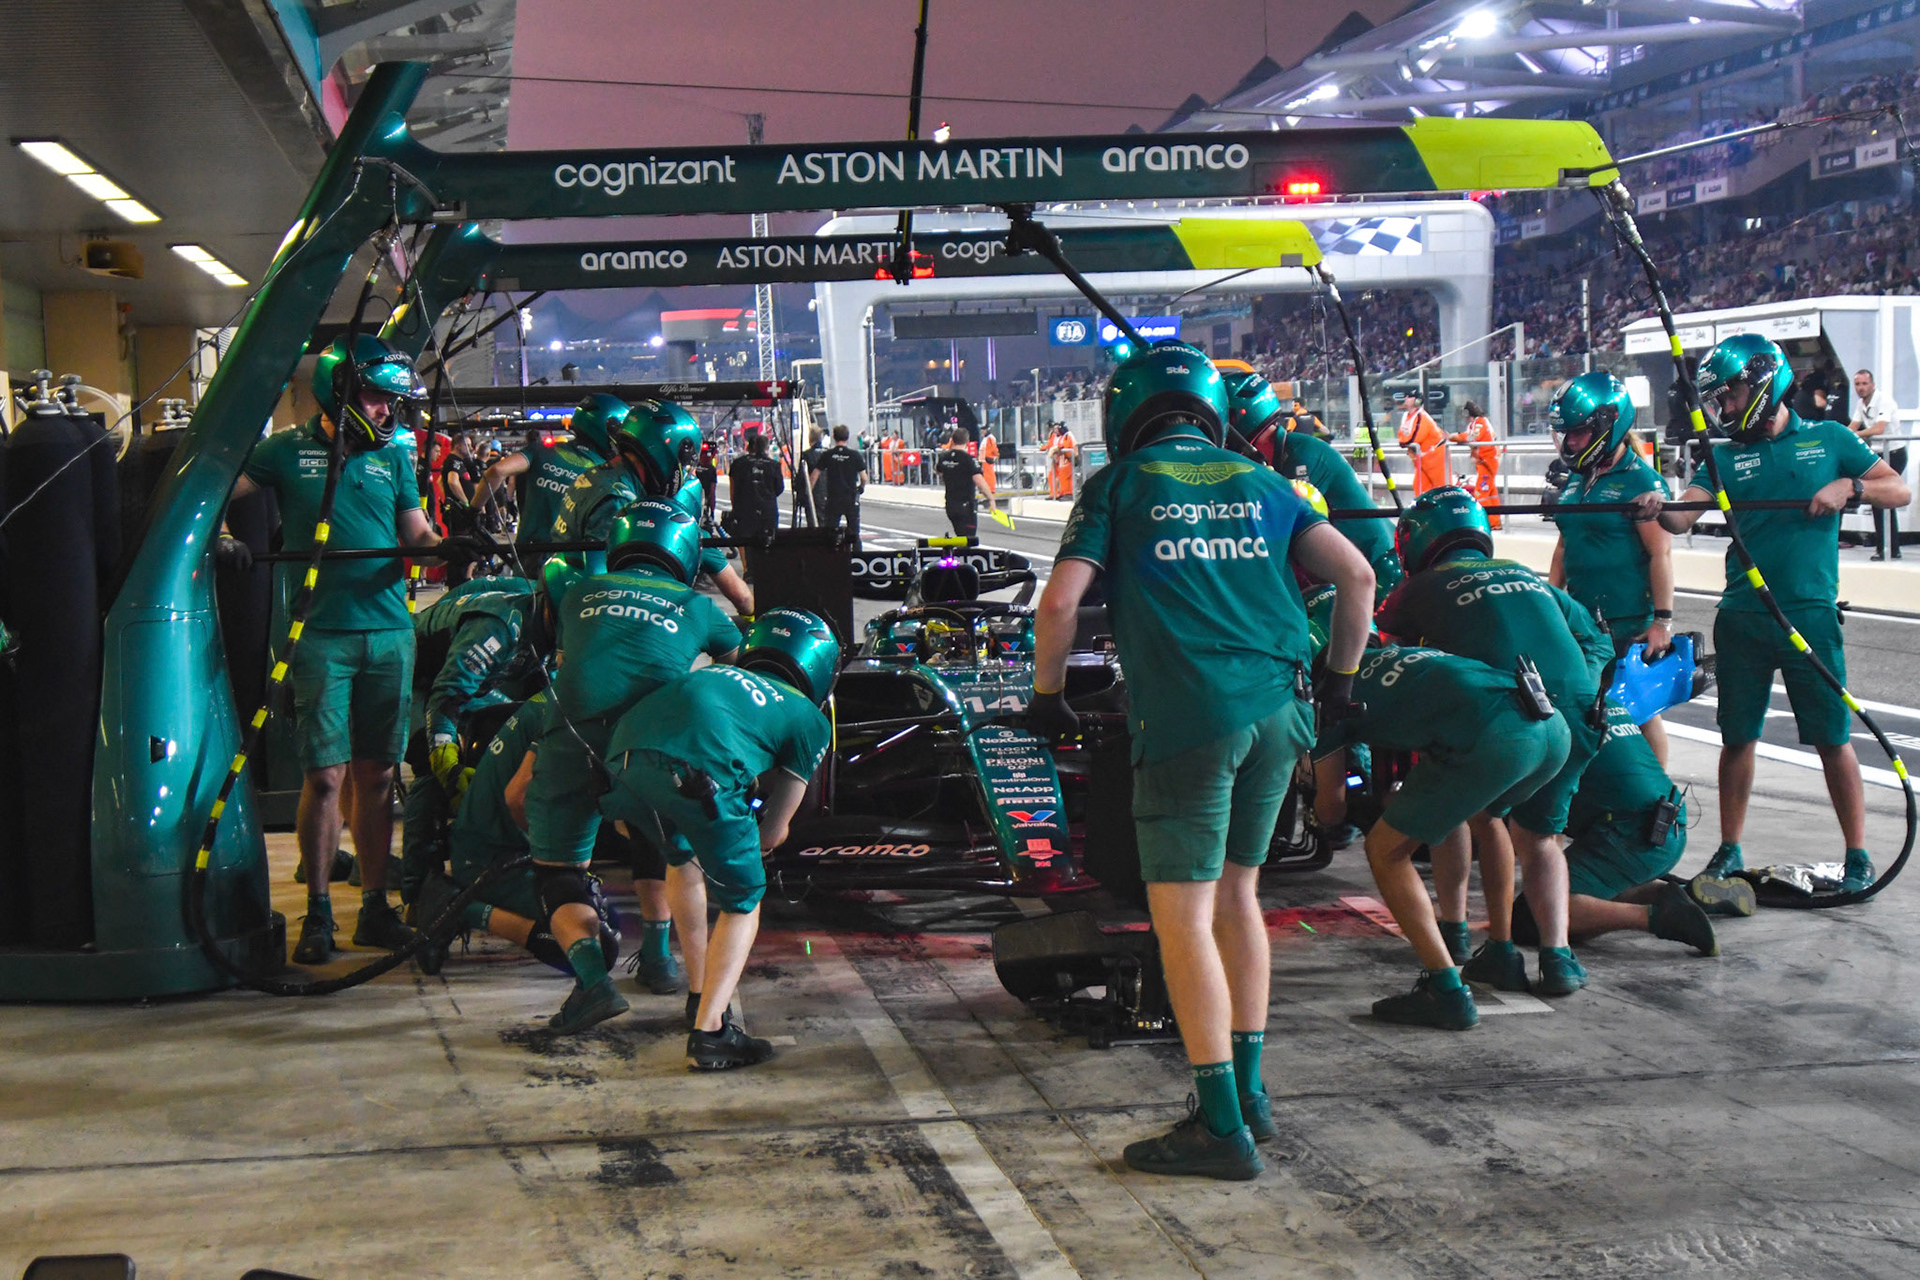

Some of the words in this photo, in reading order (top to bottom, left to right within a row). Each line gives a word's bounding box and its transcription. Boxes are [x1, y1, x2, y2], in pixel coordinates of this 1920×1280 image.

[555, 155, 736, 196] cognizant
[777, 151, 905, 185] ASTON
[917, 146, 1063, 180] MARTIN
[1102, 143, 1249, 172] aramco
[580, 249, 688, 271] aramco
[717, 245, 806, 269] ASTON
[814, 240, 915, 266] MARTI
[1147, 345, 1200, 357] aramco
[391, 375, 411, 386] aram
[1747, 393, 1769, 429] cognizant
[542, 463, 578, 480] cogniz
[1735, 458, 1760, 471] JCB
[536, 476, 570, 494] aram
[631, 501, 672, 512] aramco
[1151, 500, 1262, 524] cognizant
[582, 588, 685, 617] cognizant
[1308, 590, 1337, 607] aram
[580, 604, 679, 633] aramco
[963, 695, 1028, 713] 14
[993, 786, 1054, 794] NetApp
[1012, 821, 1057, 829] Valvoline
[799, 843, 930, 857] aramco
